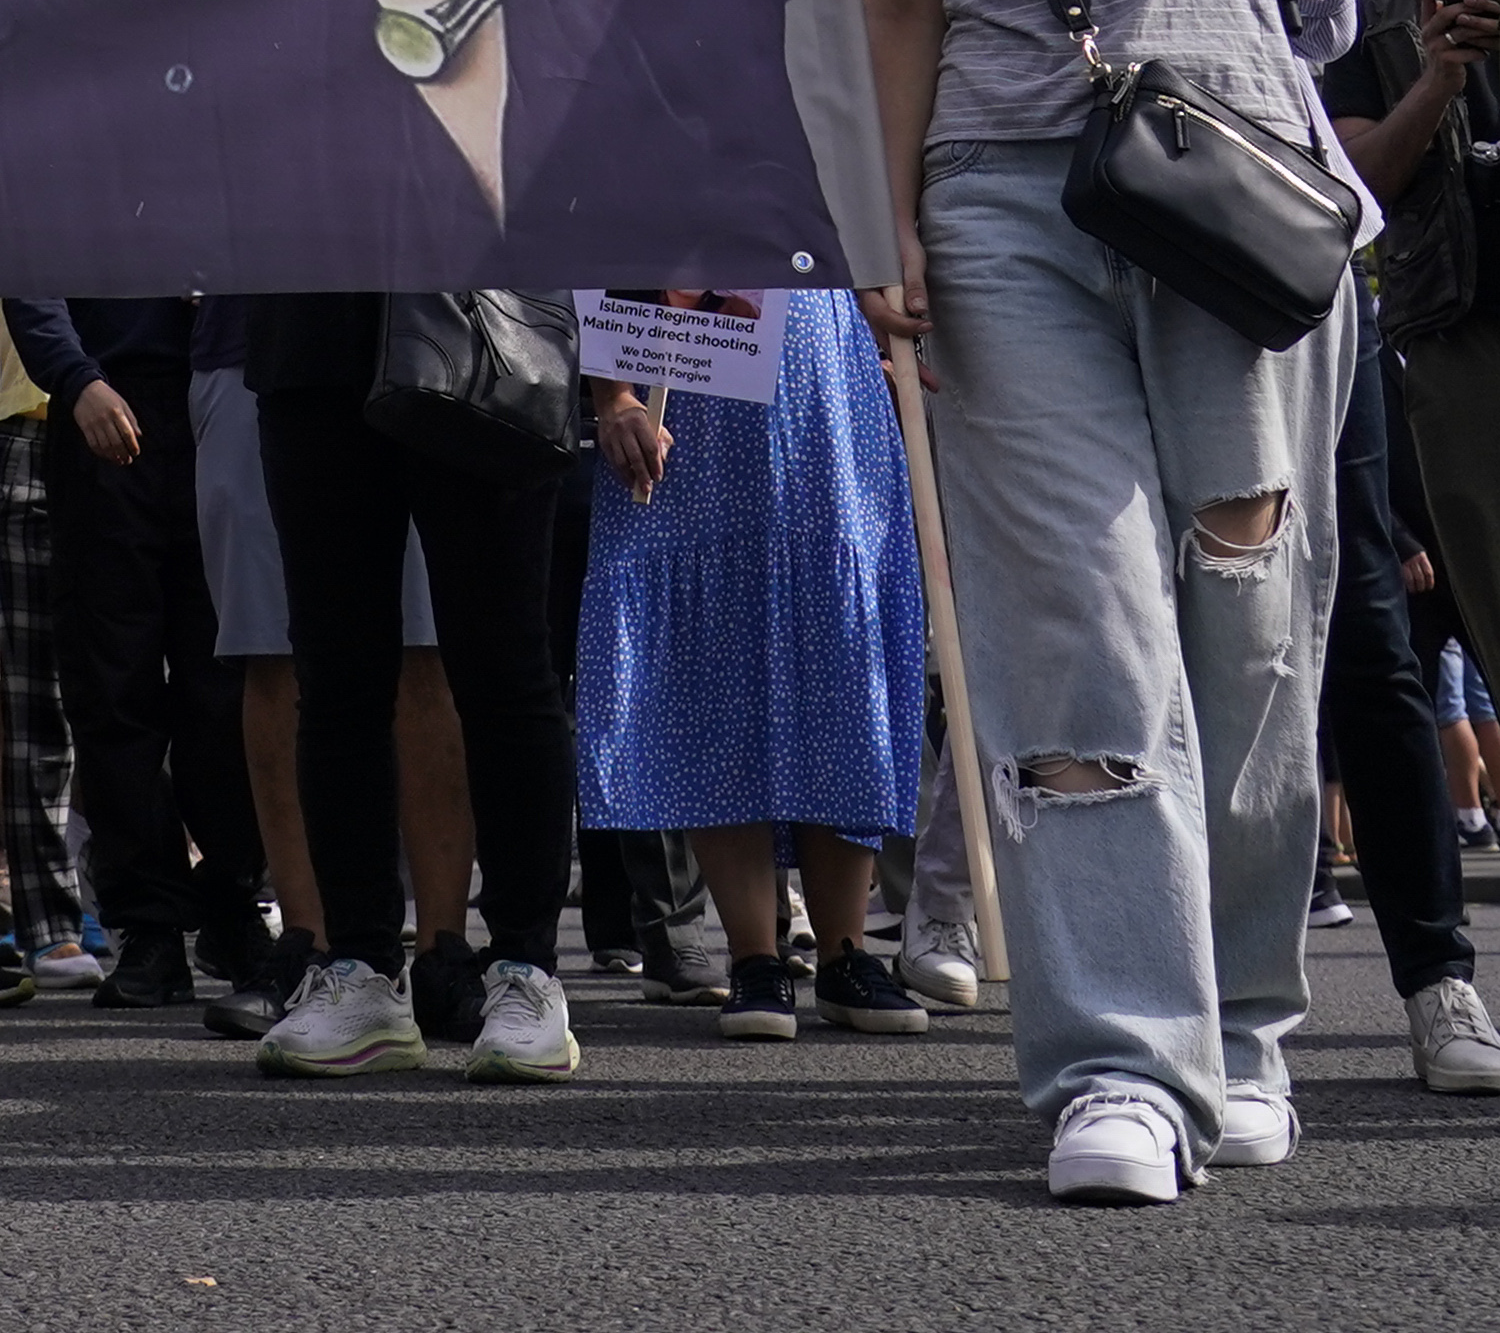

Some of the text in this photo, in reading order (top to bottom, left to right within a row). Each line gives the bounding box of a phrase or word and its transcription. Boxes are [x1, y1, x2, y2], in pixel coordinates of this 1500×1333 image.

[599, 299, 756, 334] Islamic Regime killed
[582, 315, 763, 357] Matin by direct shooting.
[615, 358, 634, 371] We
[636, 362, 667, 377] Don't
[669, 366, 712, 383] Forgive
[621, 345, 713, 369] We Don't Forget
